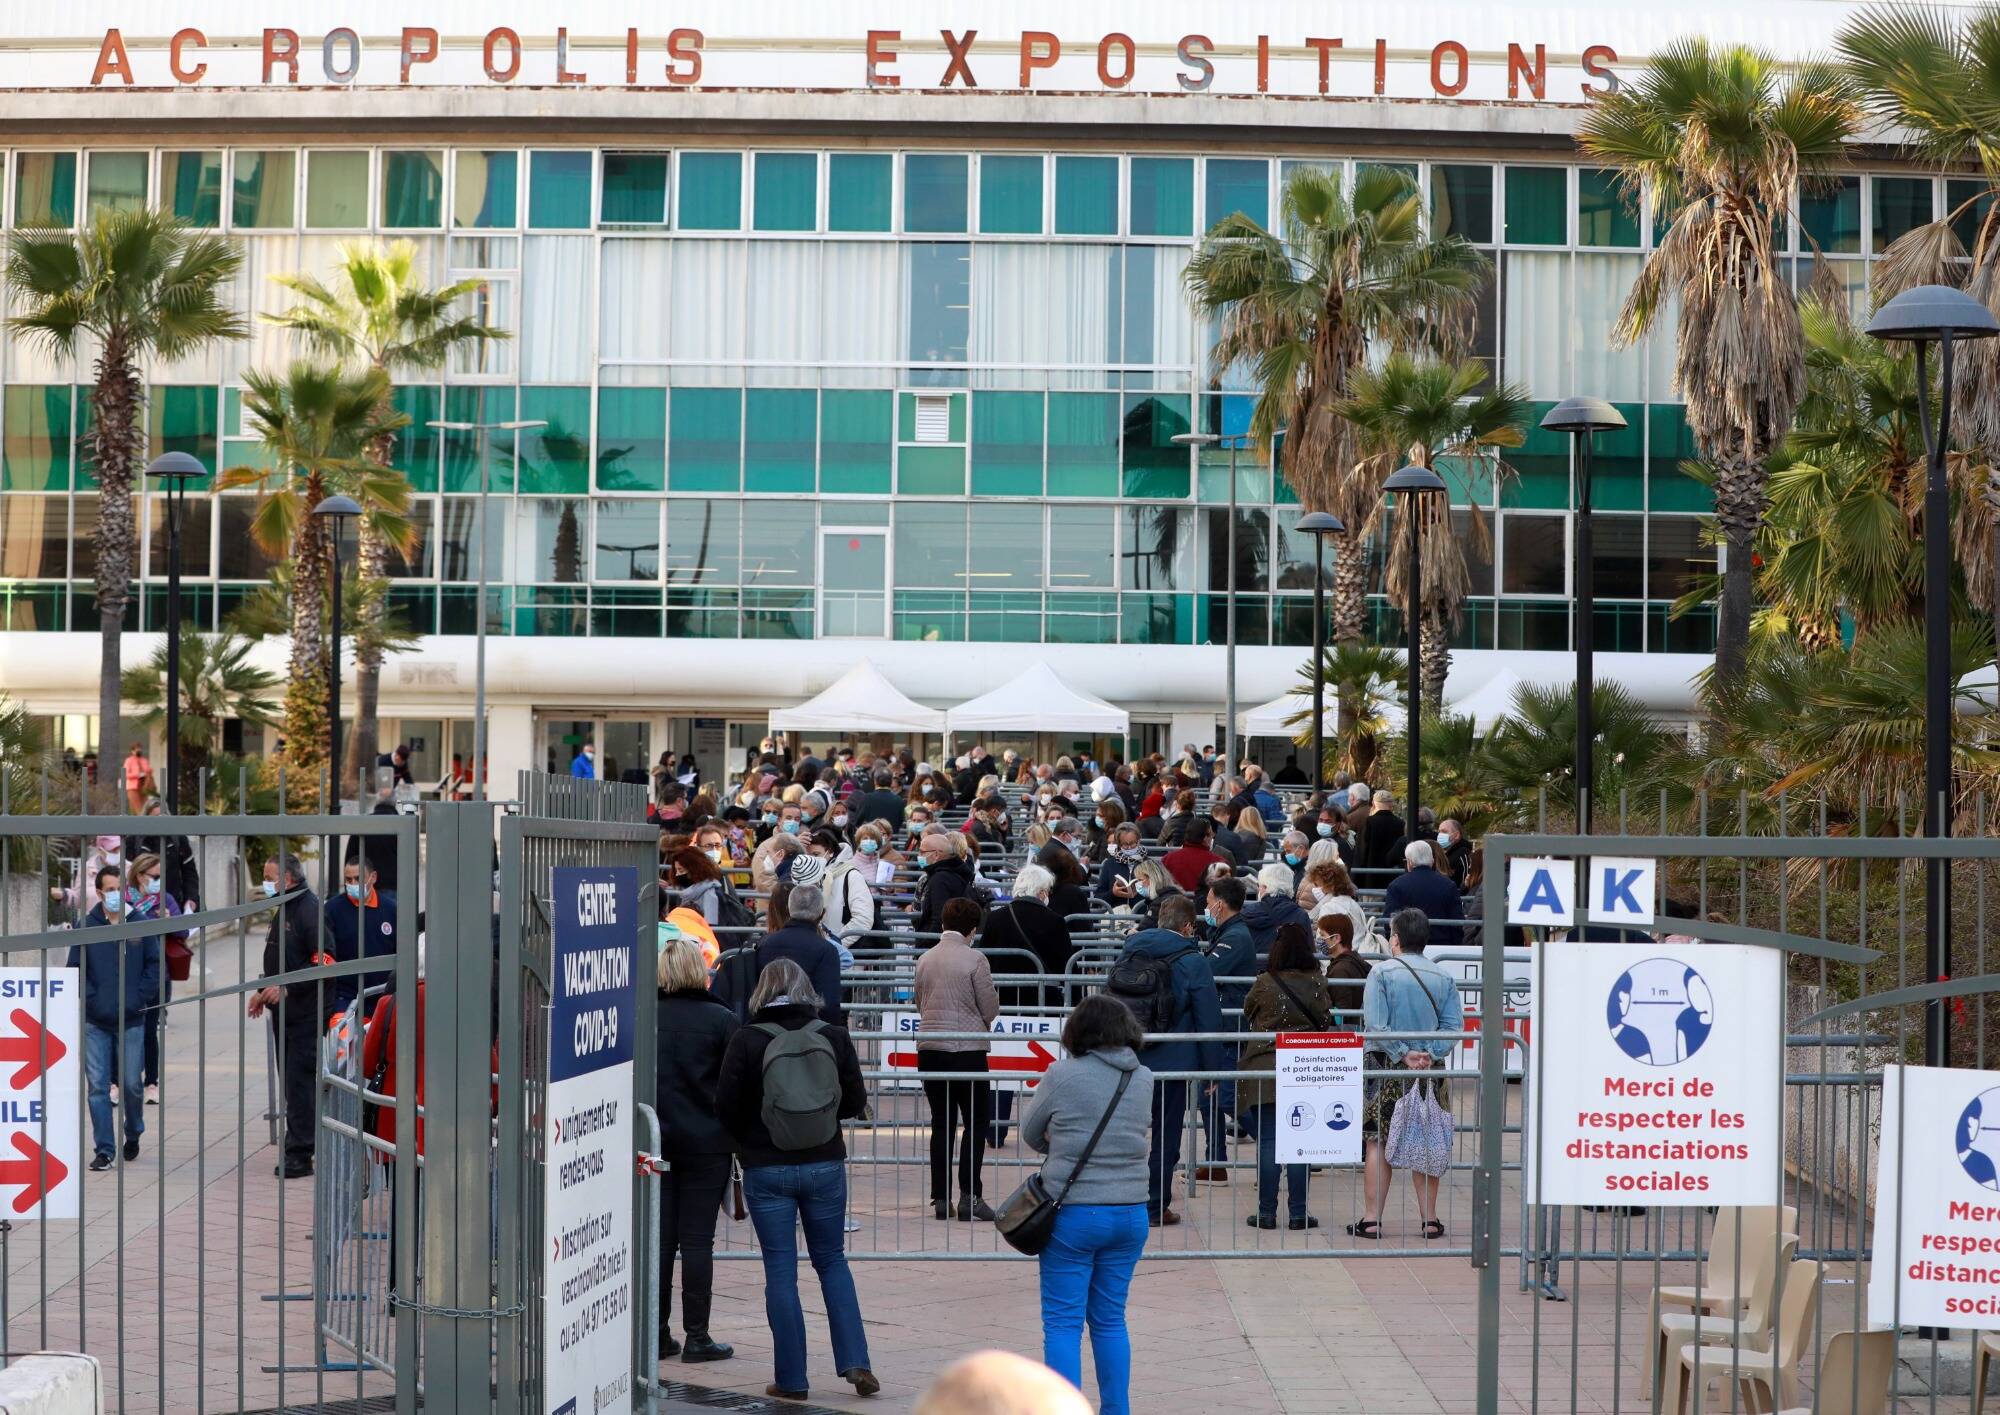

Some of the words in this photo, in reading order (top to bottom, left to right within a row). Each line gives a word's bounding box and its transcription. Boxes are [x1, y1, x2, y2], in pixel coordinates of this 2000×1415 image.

[90, 27, 704, 85] ACROPOLIS
[866, 29, 1619, 100] EXPOSITIONS
[577, 882, 617, 928] CENTRE
[1517, 868, 1565, 914] A
[1602, 867, 1644, 914] K
[1, 979, 64, 998] SITF
[563, 946, 630, 998] VACCINATION
[574, 1005, 618, 1058] COVID-19
[1293, 1065, 1311, 1074] port
[1312, 1065, 1324, 1073] du
[1326, 1066, 1359, 1074] masque
[1294, 1055, 1346, 1063] Désinfection
[1295, 1074, 1345, 1083] obligatoires
[1604, 1077, 1675, 1097] Merci
[1683, 1077, 1714, 1097] de
[562, 1098, 604, 1146] uniquement
[605, 1100, 618, 1128] sur
[1578, 1111, 1703, 1133] respecter
[1710, 1109, 1745, 1129] les
[1566, 1139, 1748, 1160] distanciations
[560, 1148, 604, 1191] rendez-vous
[1605, 1171, 1709, 1191] sociales
[1949, 1201, 2000, 1222] Mer
[562, 1212, 600, 1261] inscription
[600, 1210, 613, 1240] sur
[562, 1241, 627, 1307] vaccincovid19.nice.fr
[1908, 1260, 2000, 1284] distanc
[560, 1325, 570, 1353] ou
[571, 1318, 580, 1346] au
[581, 1305, 591, 1339] 04
[591, 1299, 600, 1333] 97
[601, 1294, 609, 1326] 13
[609, 1288, 618, 1321] 56
[619, 1282, 628, 1315] 00
[1945, 1295, 2000, 1315] soci
